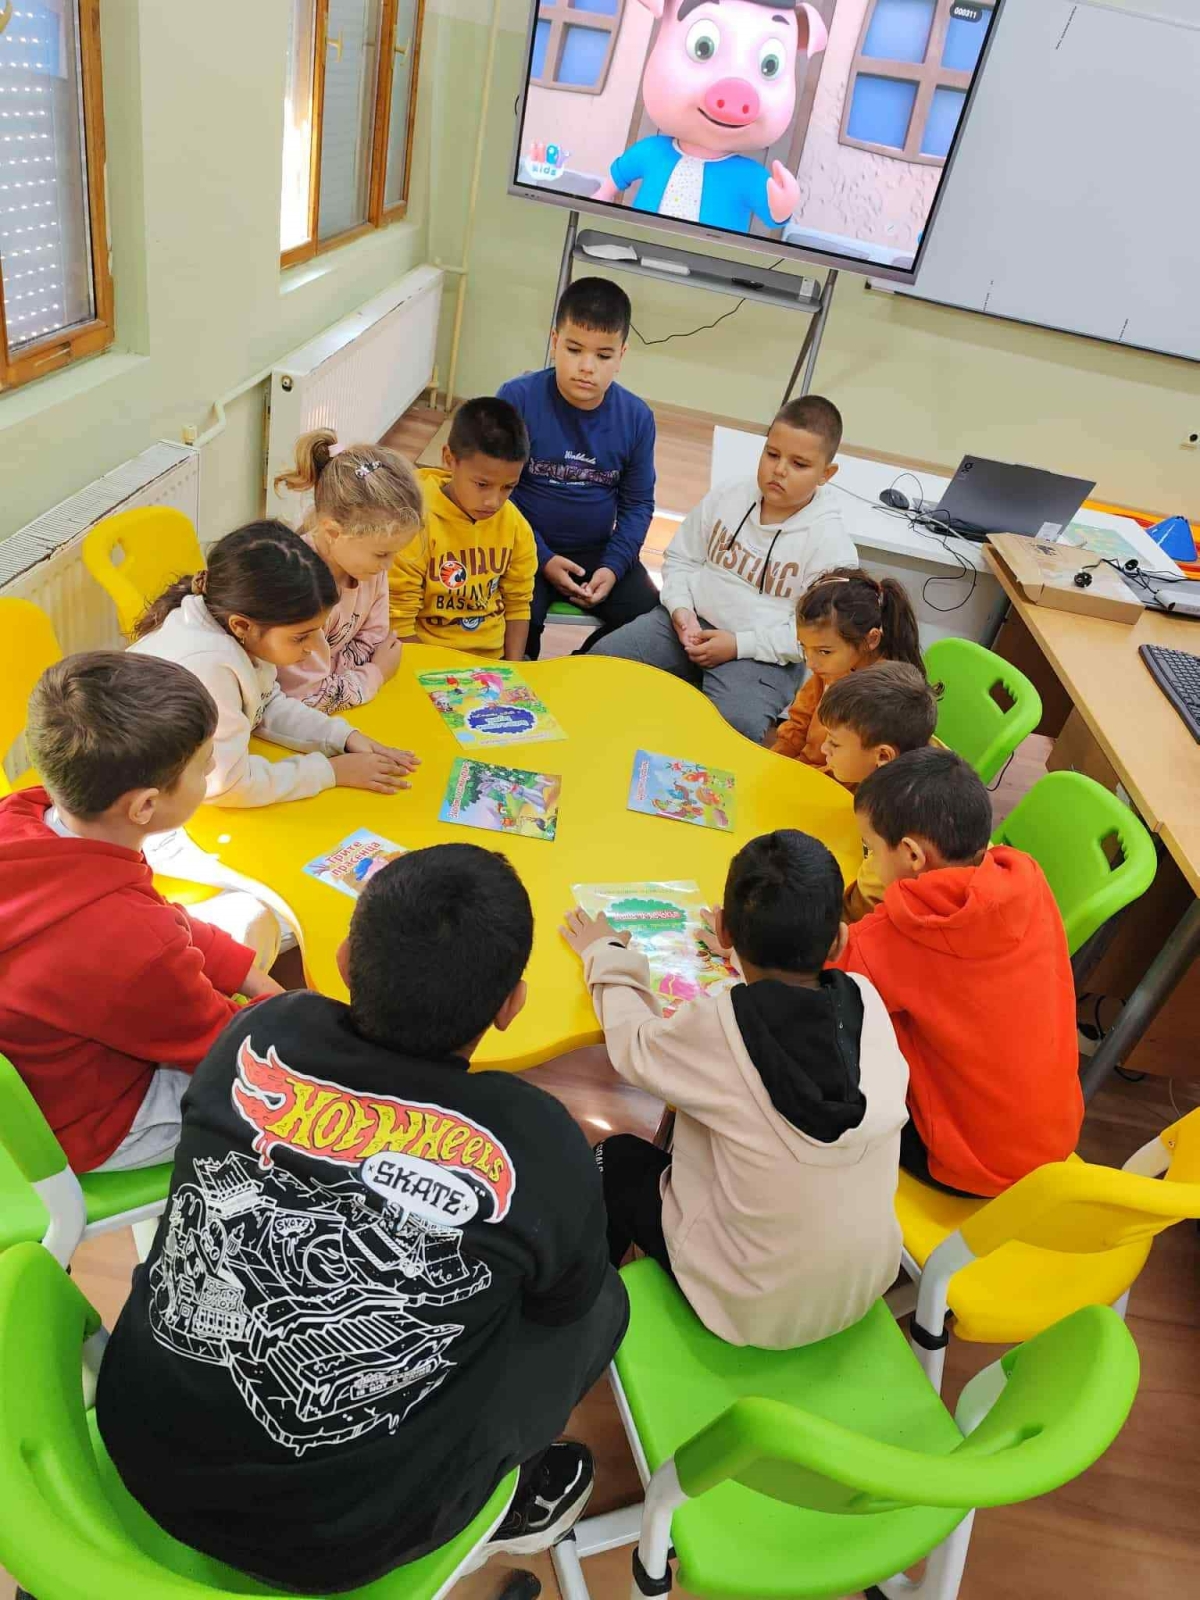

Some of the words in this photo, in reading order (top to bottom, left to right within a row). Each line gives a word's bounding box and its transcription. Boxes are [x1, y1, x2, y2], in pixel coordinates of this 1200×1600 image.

[331, 841, 381, 876] прасенца
[372, 1159, 467, 1216] SKATE
[276, 1219, 309, 1231] SKATE
